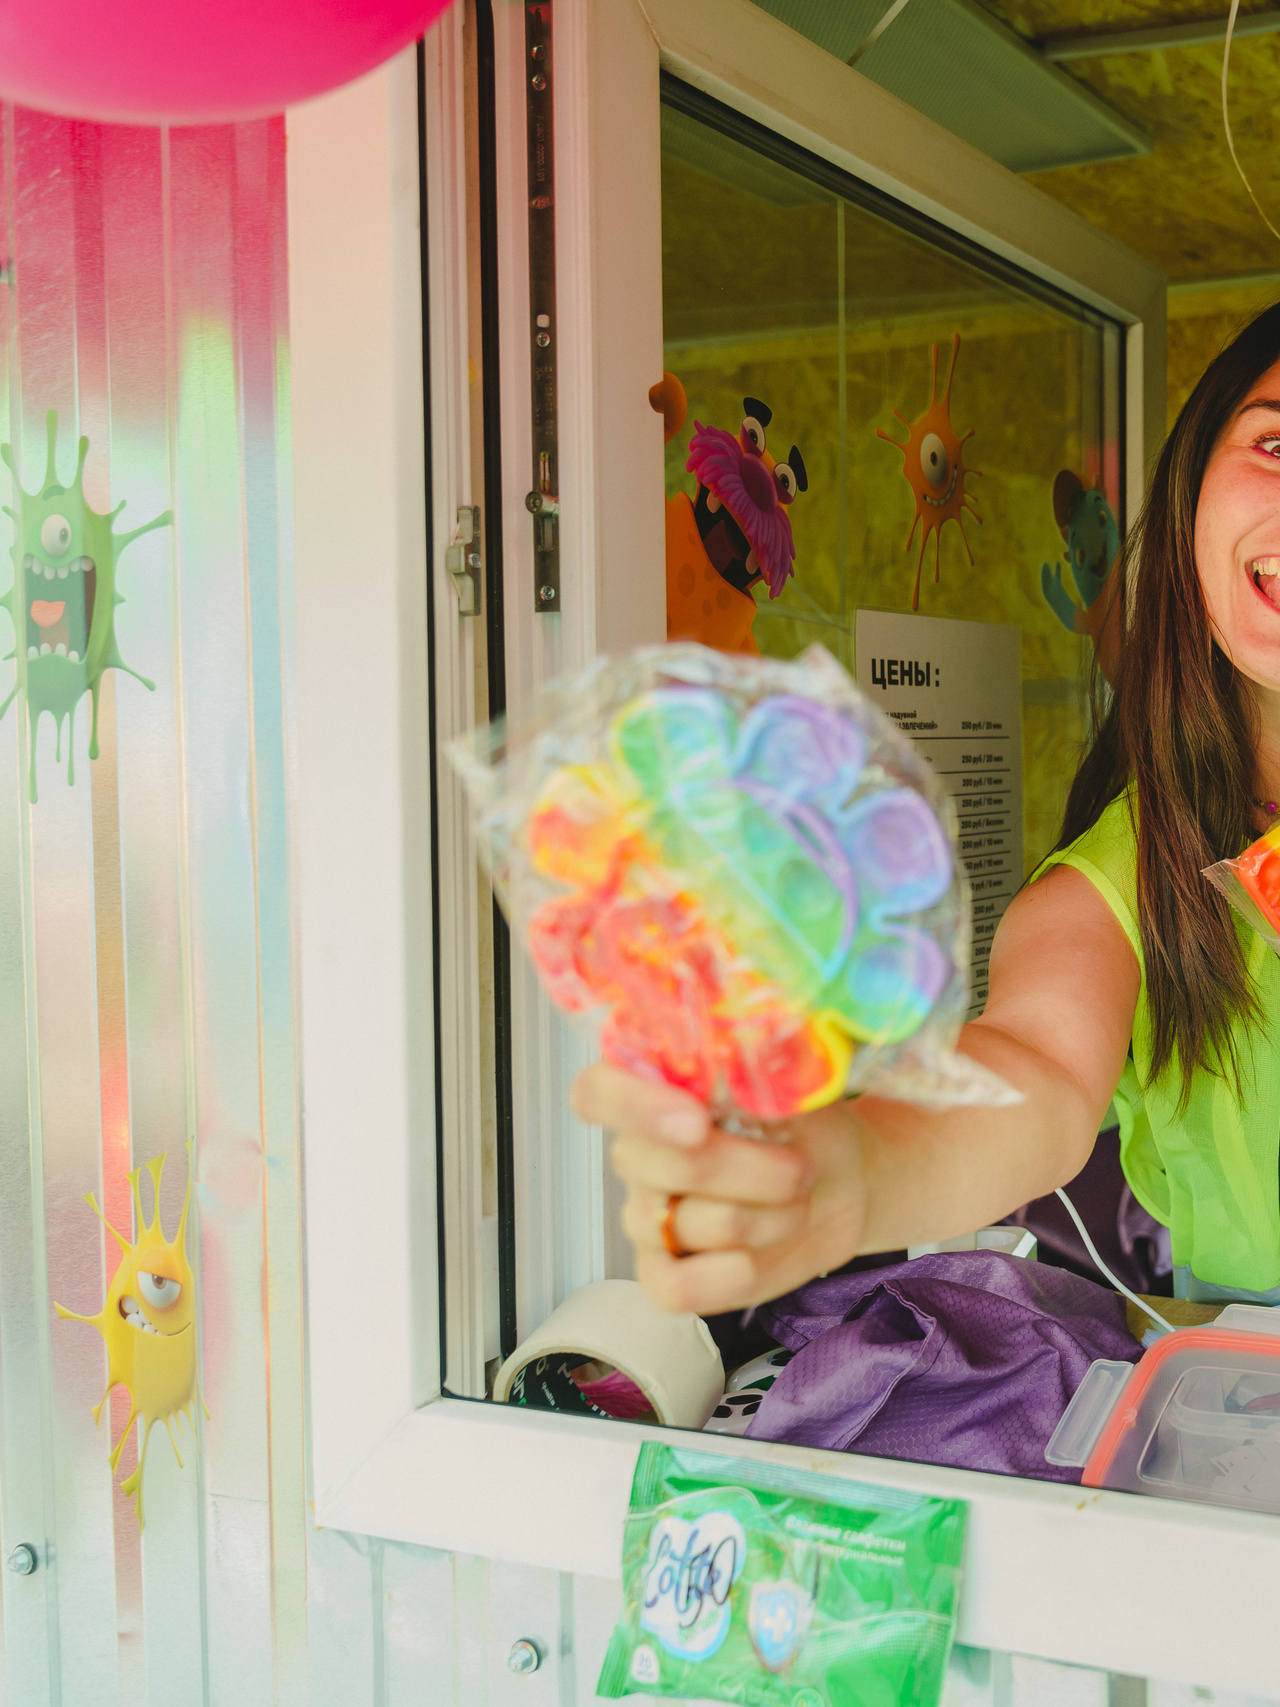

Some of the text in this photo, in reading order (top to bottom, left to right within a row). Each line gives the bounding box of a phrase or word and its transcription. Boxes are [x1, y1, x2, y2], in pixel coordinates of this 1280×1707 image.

[871, 658, 940, 691] ЦЕНЫ:
[890, 710, 917, 720] надувной
[972, 721, 983, 732] руб
[972, 754, 983, 766] руб
[973, 778, 984, 789] руб
[972, 797, 983, 809] руб
[972, 818, 982, 831] руб
[973, 838, 984, 850] руб
[973, 860, 983, 871] руб
[785, 1514, 906, 1554] Влажные салфетки
